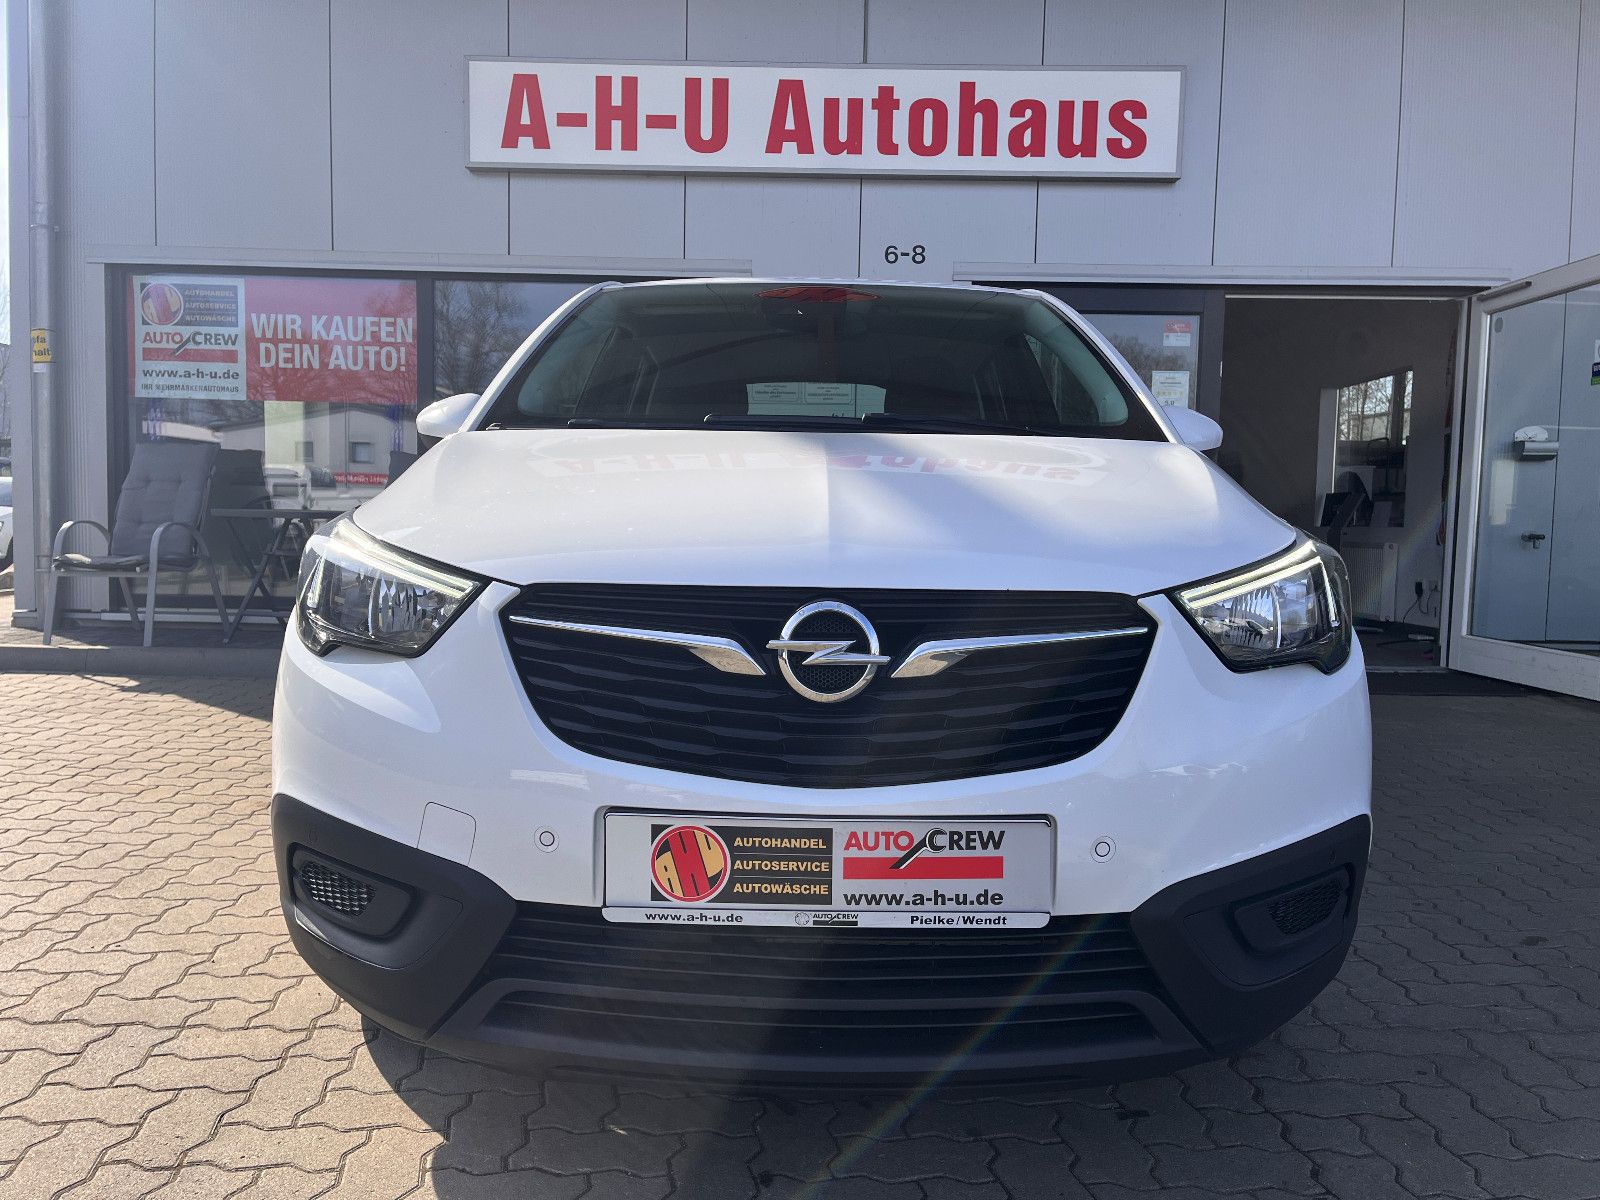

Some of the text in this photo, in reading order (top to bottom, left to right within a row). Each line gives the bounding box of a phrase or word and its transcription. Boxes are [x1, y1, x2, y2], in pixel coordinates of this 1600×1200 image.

[500, 72, 1148, 160] A-H-U Autohaus
[884, 244, 926, 265] 6-8
[250, 312, 413, 343] WIR KAUFEN
[259, 342, 406, 372] DEIN AUTO!
[142, 368, 240, 380] www.a-h-u.de
[733, 836, 827, 849] AUTOHANDEL
[733, 860, 830, 872] AUTOSERVICE
[733, 882, 829, 895] AUTOWÄSCHE
[843, 888, 1004, 906] www.a-h-u.de
[645, 912, 744, 923] www.a-h-u.de
[910, 915, 1008, 926] Pielke/Wendt
